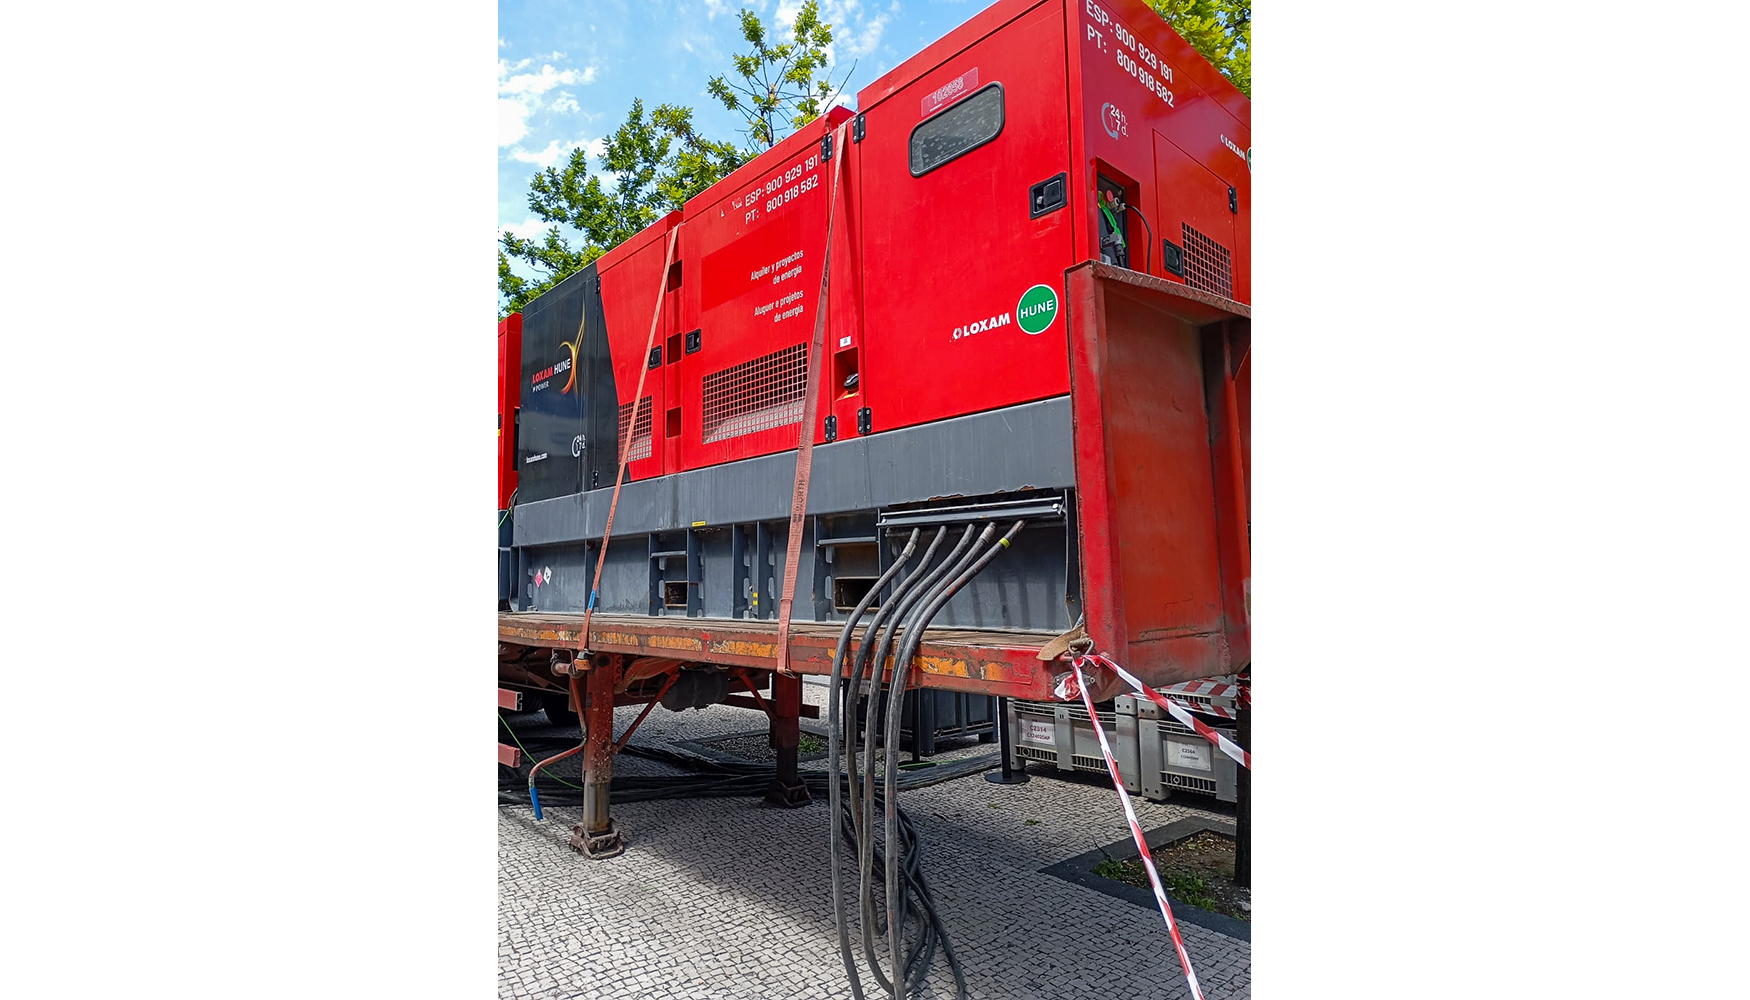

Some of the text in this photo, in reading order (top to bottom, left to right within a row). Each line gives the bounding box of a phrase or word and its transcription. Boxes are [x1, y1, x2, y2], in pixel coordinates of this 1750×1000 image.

[1086, 0, 1173, 84] ESP: 900 929 191
[1087, 23, 1174, 108] PT: 800 918 582
[1110, 104, 1120, 119] 24
[1115, 119, 1121, 131] 7
[1225, 138, 1246, 161] LOXAM
[745, 154, 819, 208] ESP: 900 929 191
[745, 174, 818, 225] PT: 800 918 582
[751, 266, 770, 281] Alquiler
[775, 250, 803, 271] proyectos
[773, 274, 780, 285] de
[754, 302, 775, 317] Aluguer
[780, 290, 803, 309] projetos
[774, 312, 781, 323] de
[963, 299, 1054, 337] LOXAM HUNE
[532, 358, 571, 384] LOXAM HUNE
[1030, 724, 1047, 733] C2314
